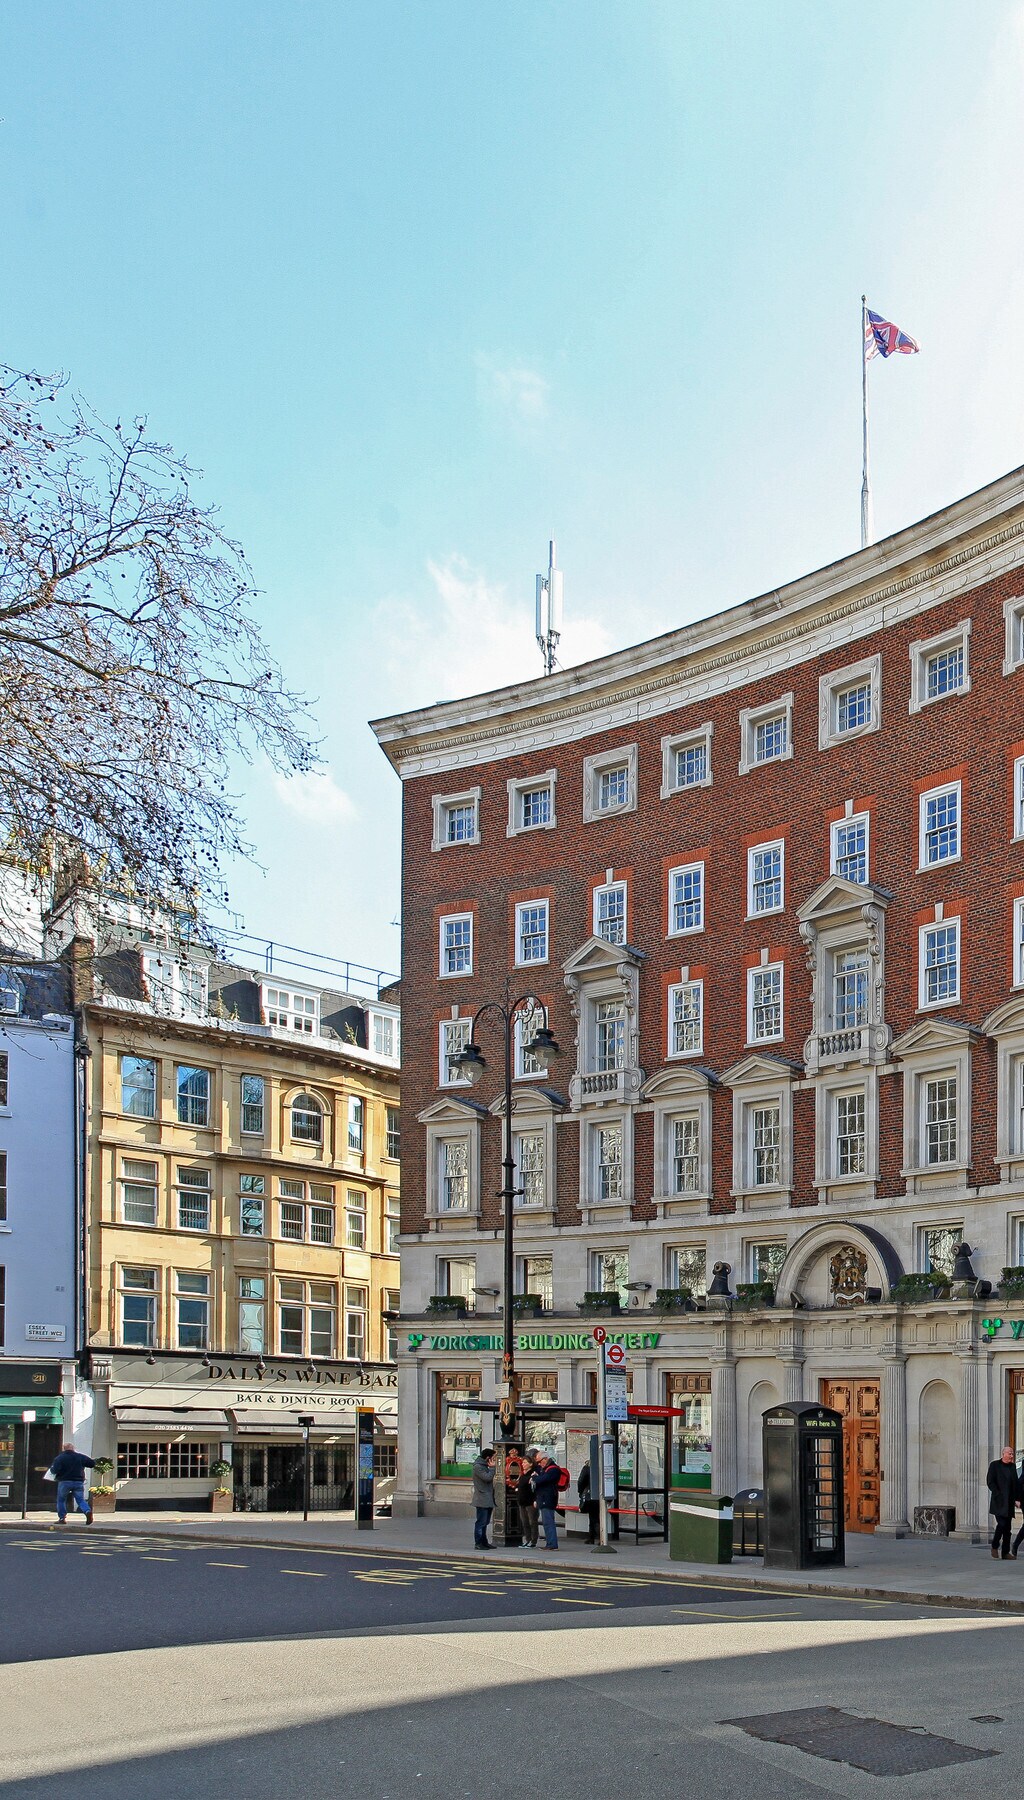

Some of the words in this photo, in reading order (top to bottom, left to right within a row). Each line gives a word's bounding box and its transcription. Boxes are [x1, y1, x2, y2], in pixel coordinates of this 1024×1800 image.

[428, 1334, 504, 1351] YORKSHIR
[517, 1333, 589, 1351] BUILDING
[594, 1333, 660, 1350] CIETY
[597, 1329, 604, 1340] P
[207, 1365, 288, 1383] DALY'S
[294, 1369, 351, 1386] WINE
[358, 1373, 398, 1388] BAR
[237, 1393, 263, 1404] BAR
[266, 1394, 277, 1404] &
[281, 1395, 326, 1406] DINING
[330, 1396, 365, 1407] ROOM
